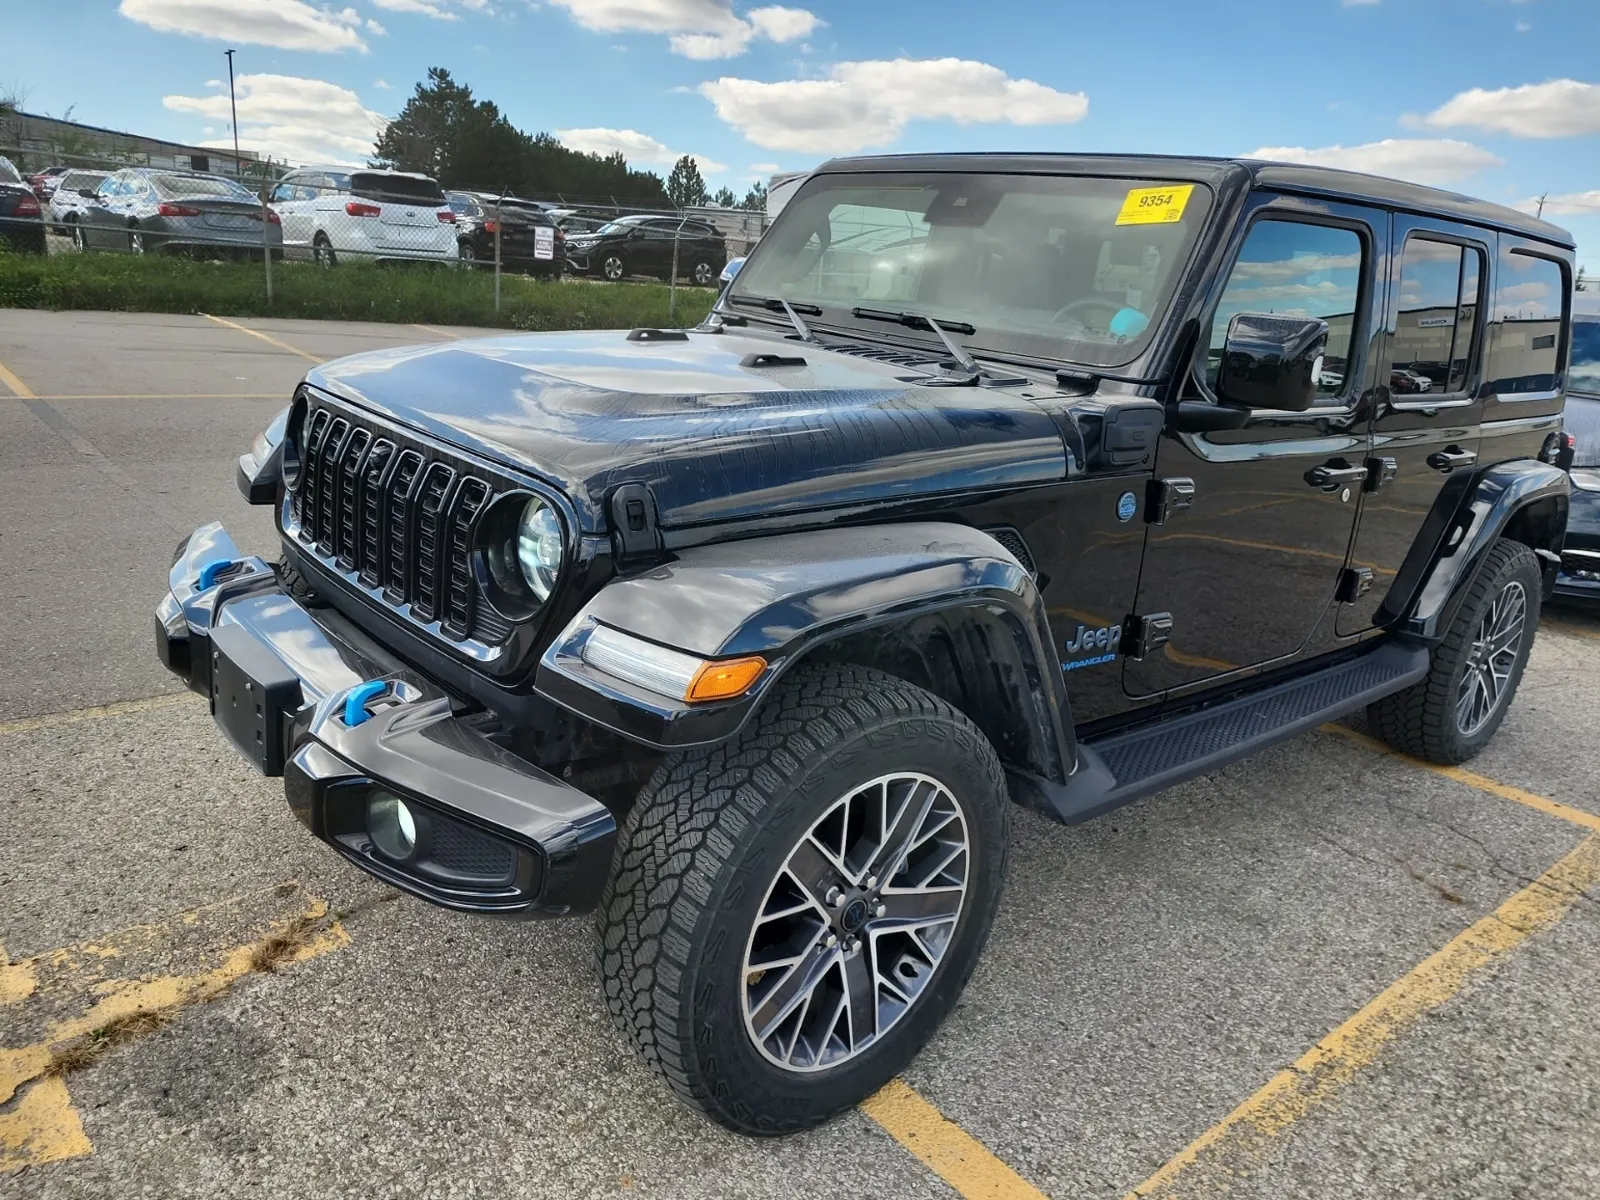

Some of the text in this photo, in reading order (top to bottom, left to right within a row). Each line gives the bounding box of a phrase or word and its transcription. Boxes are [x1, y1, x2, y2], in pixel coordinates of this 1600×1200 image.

[1138, 194, 1173, 208] 9354
[1066, 625, 1121, 653] Jeep
[1061, 653, 1116, 671] WRANGLER
